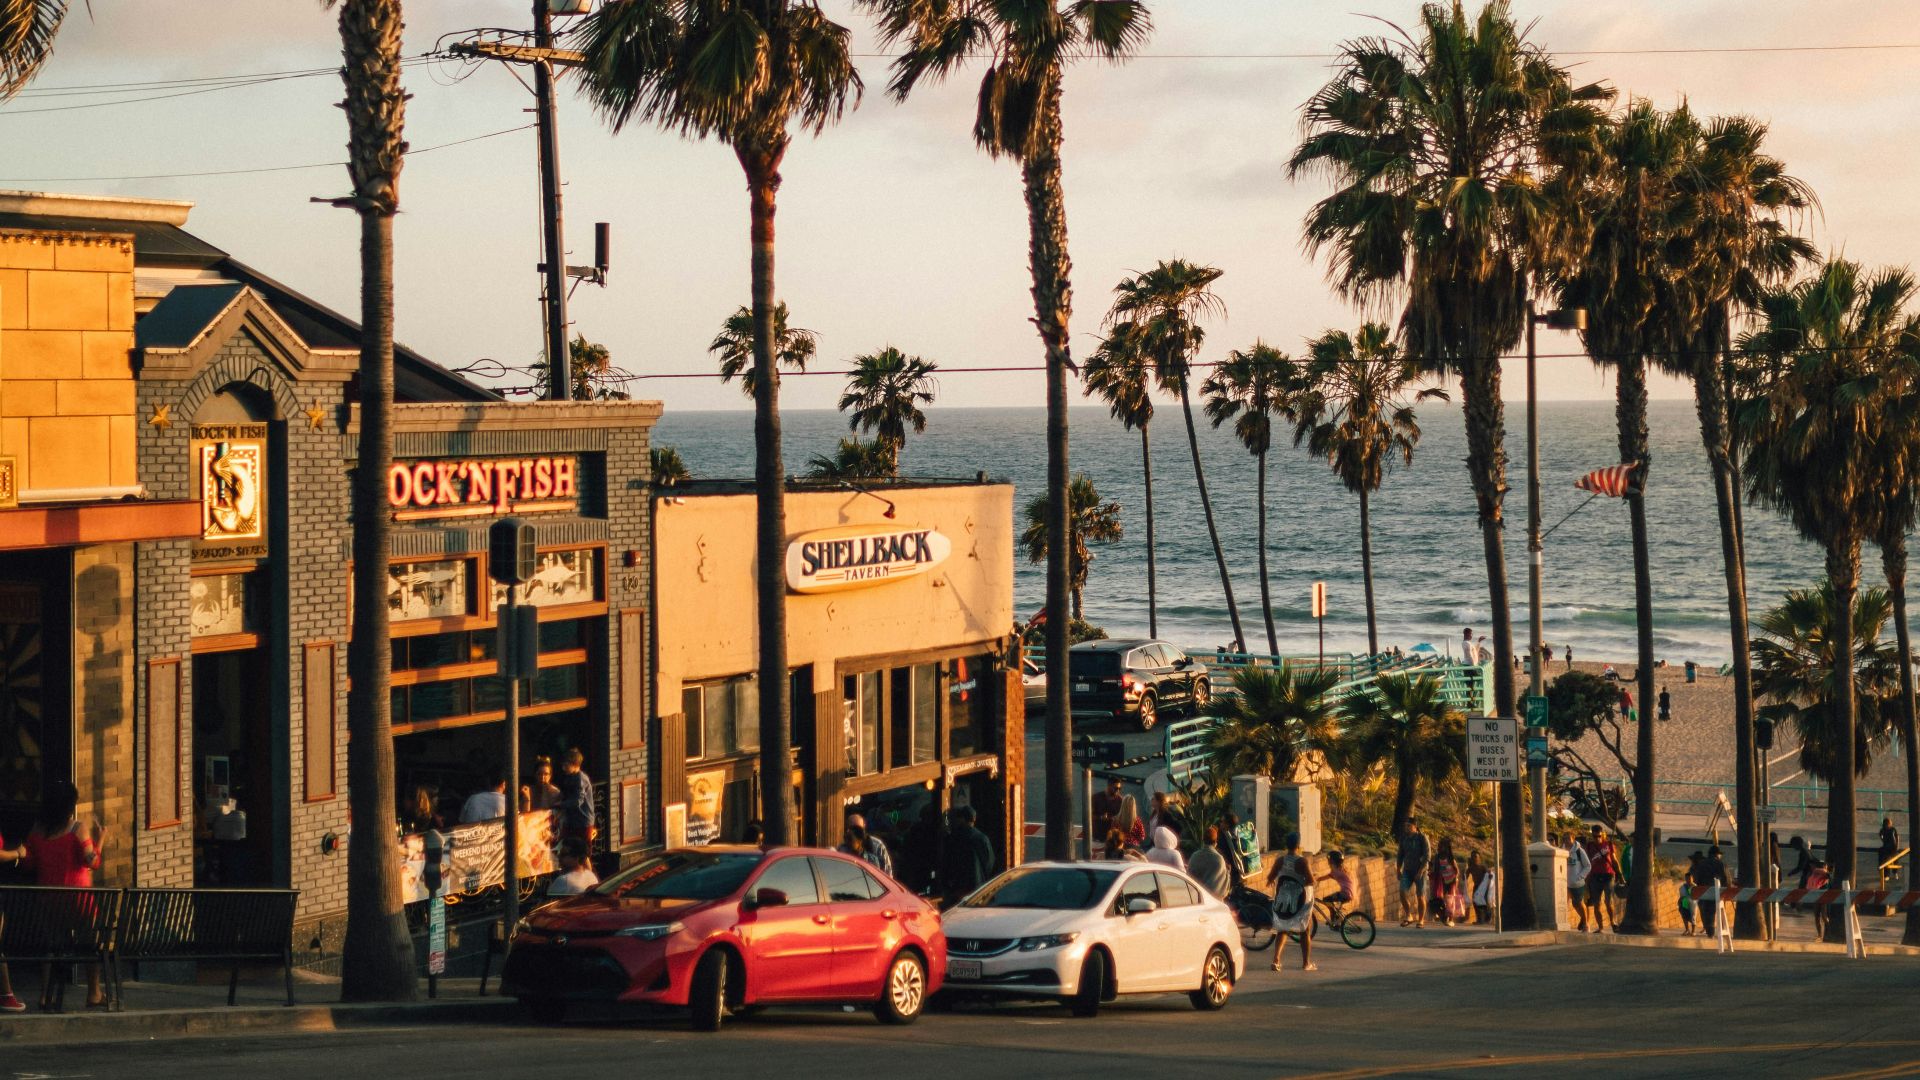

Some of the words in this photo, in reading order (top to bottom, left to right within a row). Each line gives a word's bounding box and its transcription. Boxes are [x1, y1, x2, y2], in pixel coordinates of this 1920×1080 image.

[191, 426, 237, 440] ROCK'N
[240, 425, 265, 439] FISH
[801, 530, 933, 577] SHELLBACK
[844, 565, 890, 581] TAVERN
[1484, 721, 1499, 732] NO
[1471, 734, 1500, 743] TRUCKS
[1503, 734, 1514, 743] OR
[1088, 746, 1097, 758] Dr
[1480, 746, 1505, 755] BUSES
[1476, 757, 1496, 766] WEST
[1499, 757, 1510, 766] OF
[1473, 768, 1498, 777] OCEAN
[453, 845, 481, 859] WEEKEND
[482, 841, 504, 854] BRUNCH
